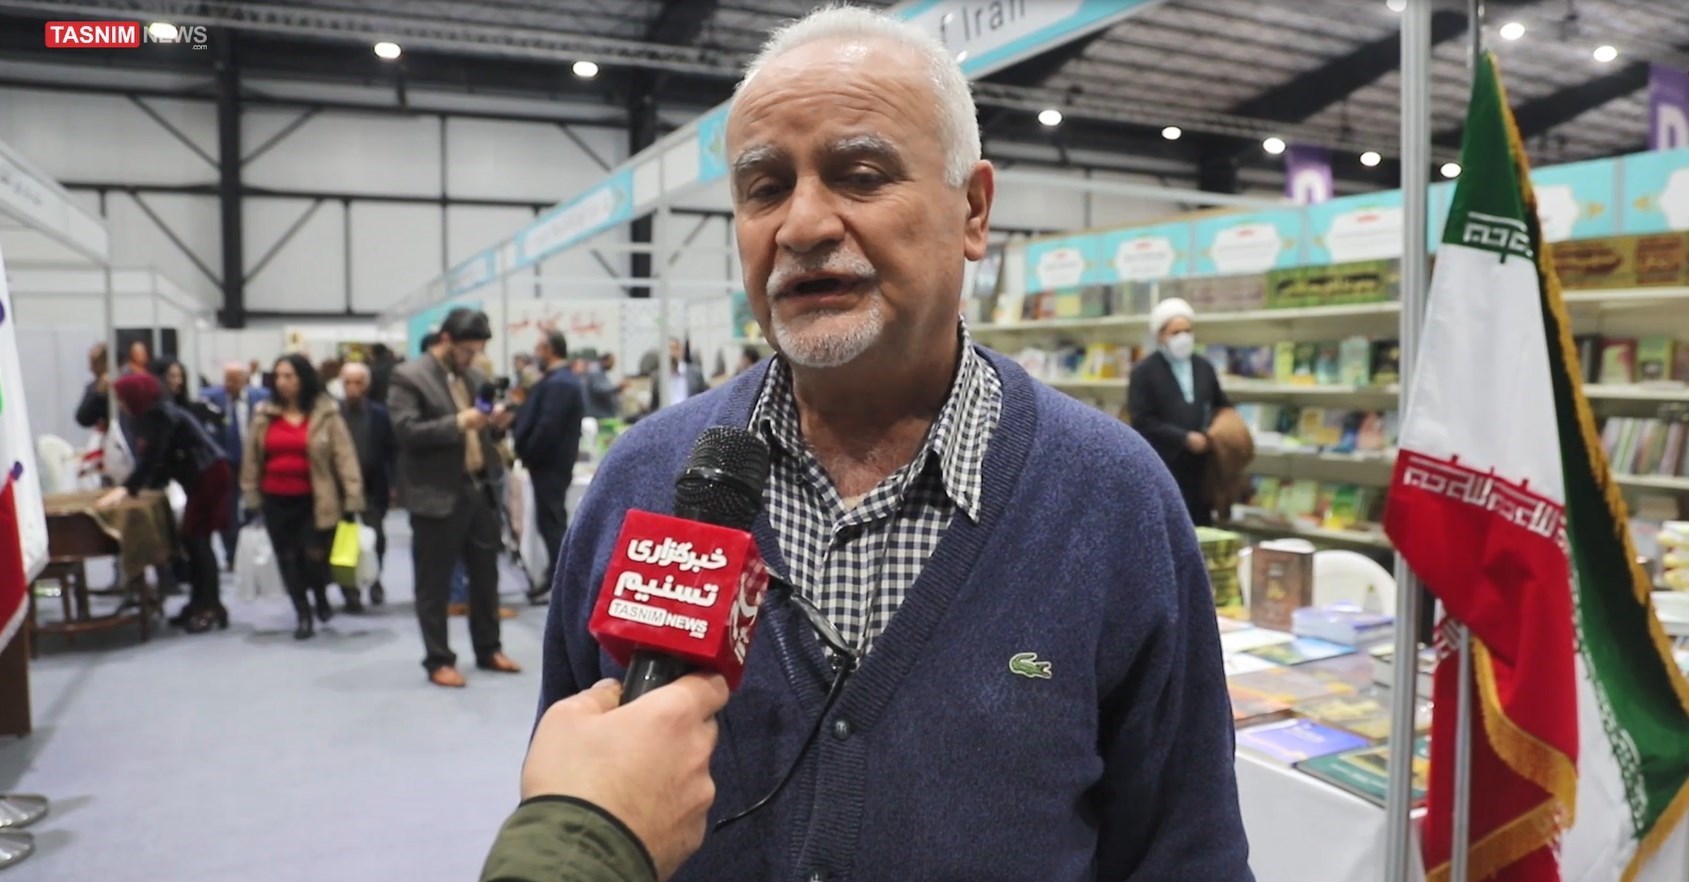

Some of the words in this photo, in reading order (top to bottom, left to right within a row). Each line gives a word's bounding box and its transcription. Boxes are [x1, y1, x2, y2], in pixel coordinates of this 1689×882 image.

[962, 0, 1025, 41] Iran
[627, 537, 728, 572] خبرگزاری
[613, 571, 719, 607] تسنیم
[613, 602, 663, 623] TASNIM
[665, 612, 708, 633] NEWS
